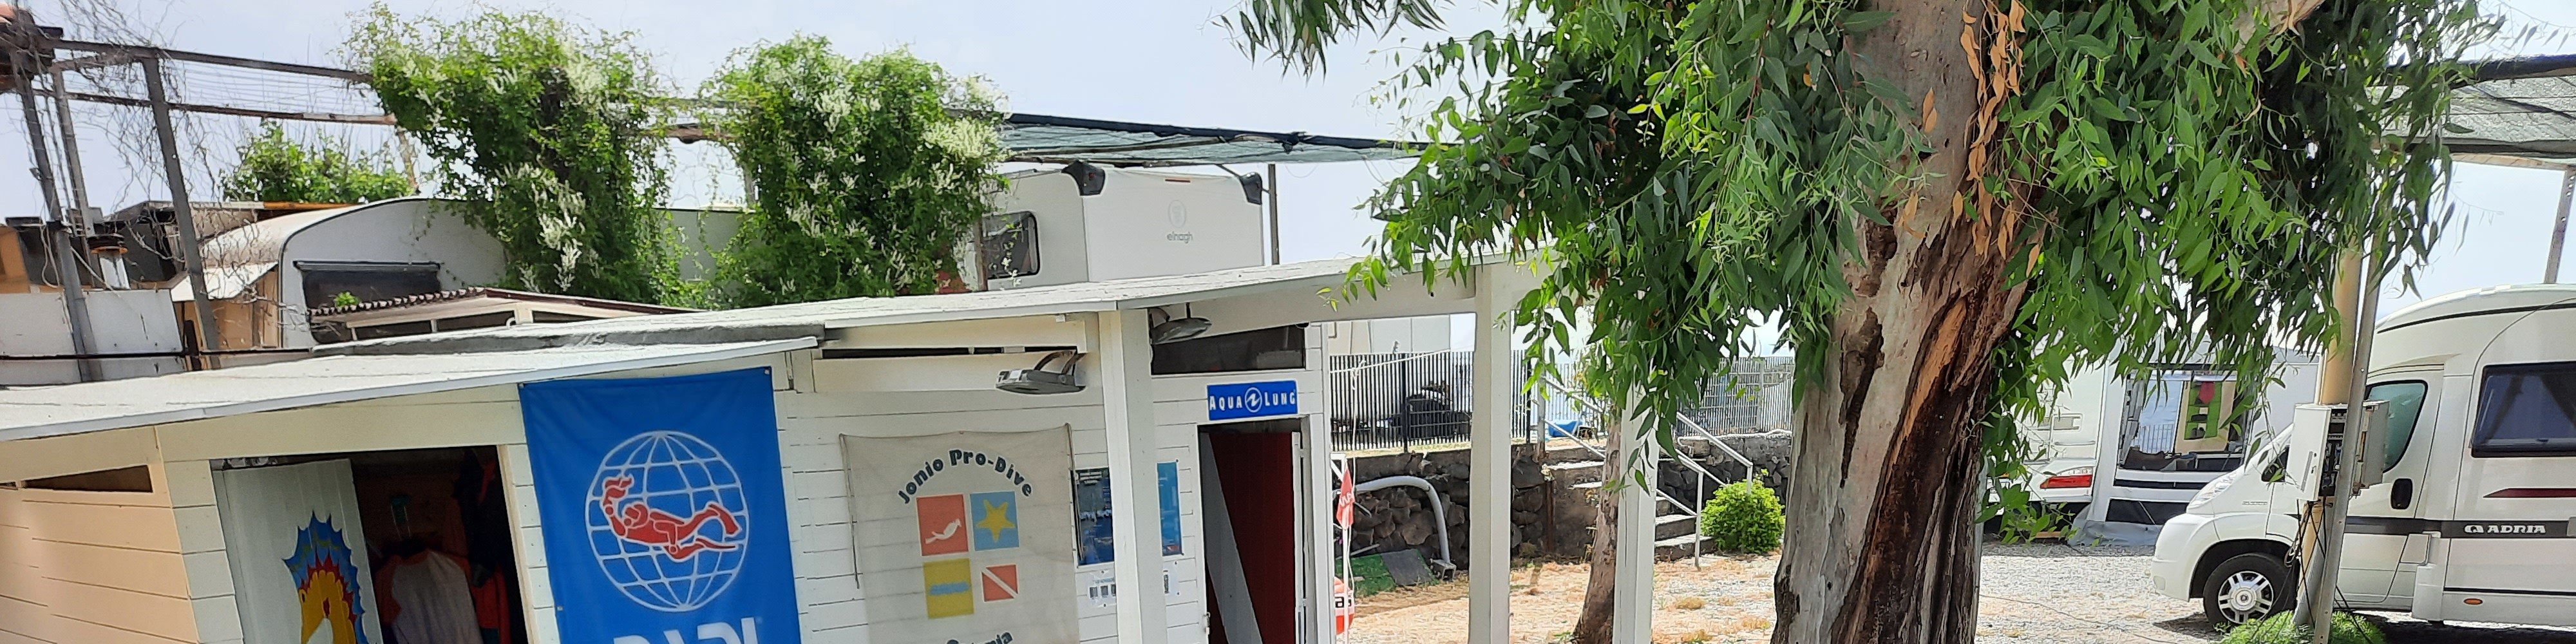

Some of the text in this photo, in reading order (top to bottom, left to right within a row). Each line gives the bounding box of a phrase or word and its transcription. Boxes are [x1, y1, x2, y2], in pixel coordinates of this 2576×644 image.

[1209, 392, 1296, 411] AQUA LUNG
[898, 449, 1032, 504] Jonio Pro-Dive
[2487, 524, 2546, 534] ADRIA
